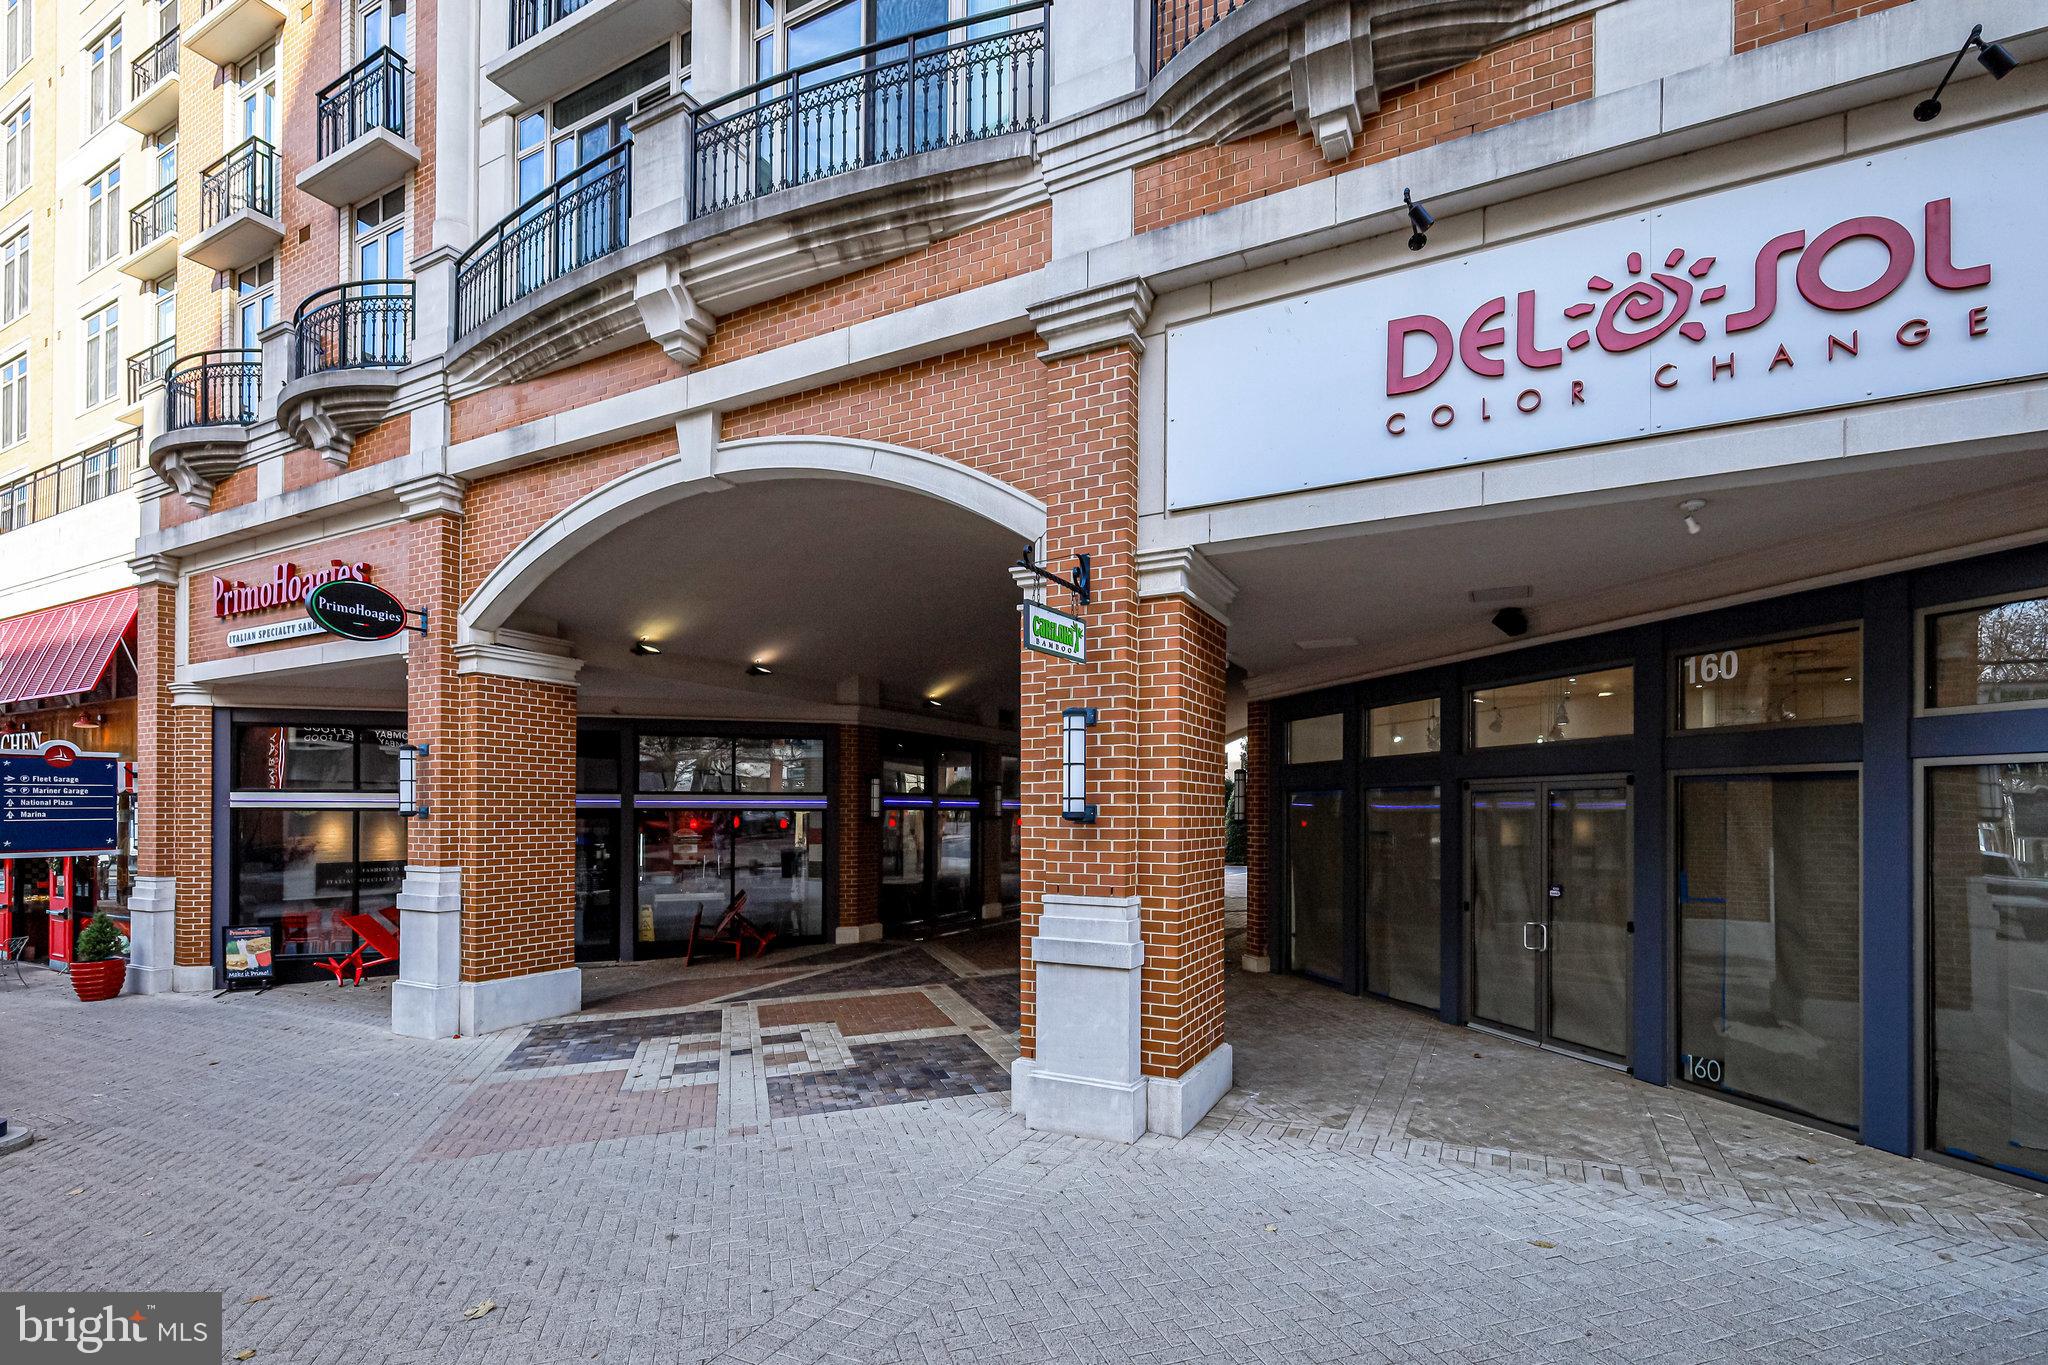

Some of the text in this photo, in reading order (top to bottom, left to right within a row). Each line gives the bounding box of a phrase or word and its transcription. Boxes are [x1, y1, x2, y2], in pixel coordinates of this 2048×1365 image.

[1386, 197, 1992, 397] DEL SOL
[1386, 306, 1990, 436] COLOR CHANGE
[318, 595, 402, 622] PrimoHoagies
[229, 632, 257, 644] ITALIAN
[258, 624, 297, 639] SPECIALTY
[1035, 638, 1073, 653] BAMBOO
[1684, 650, 1739, 684] 160
[53, 775, 80, 784] Garage
[63, 787, 89, 795] Garage
[1687, 1054, 1721, 1082] 160
